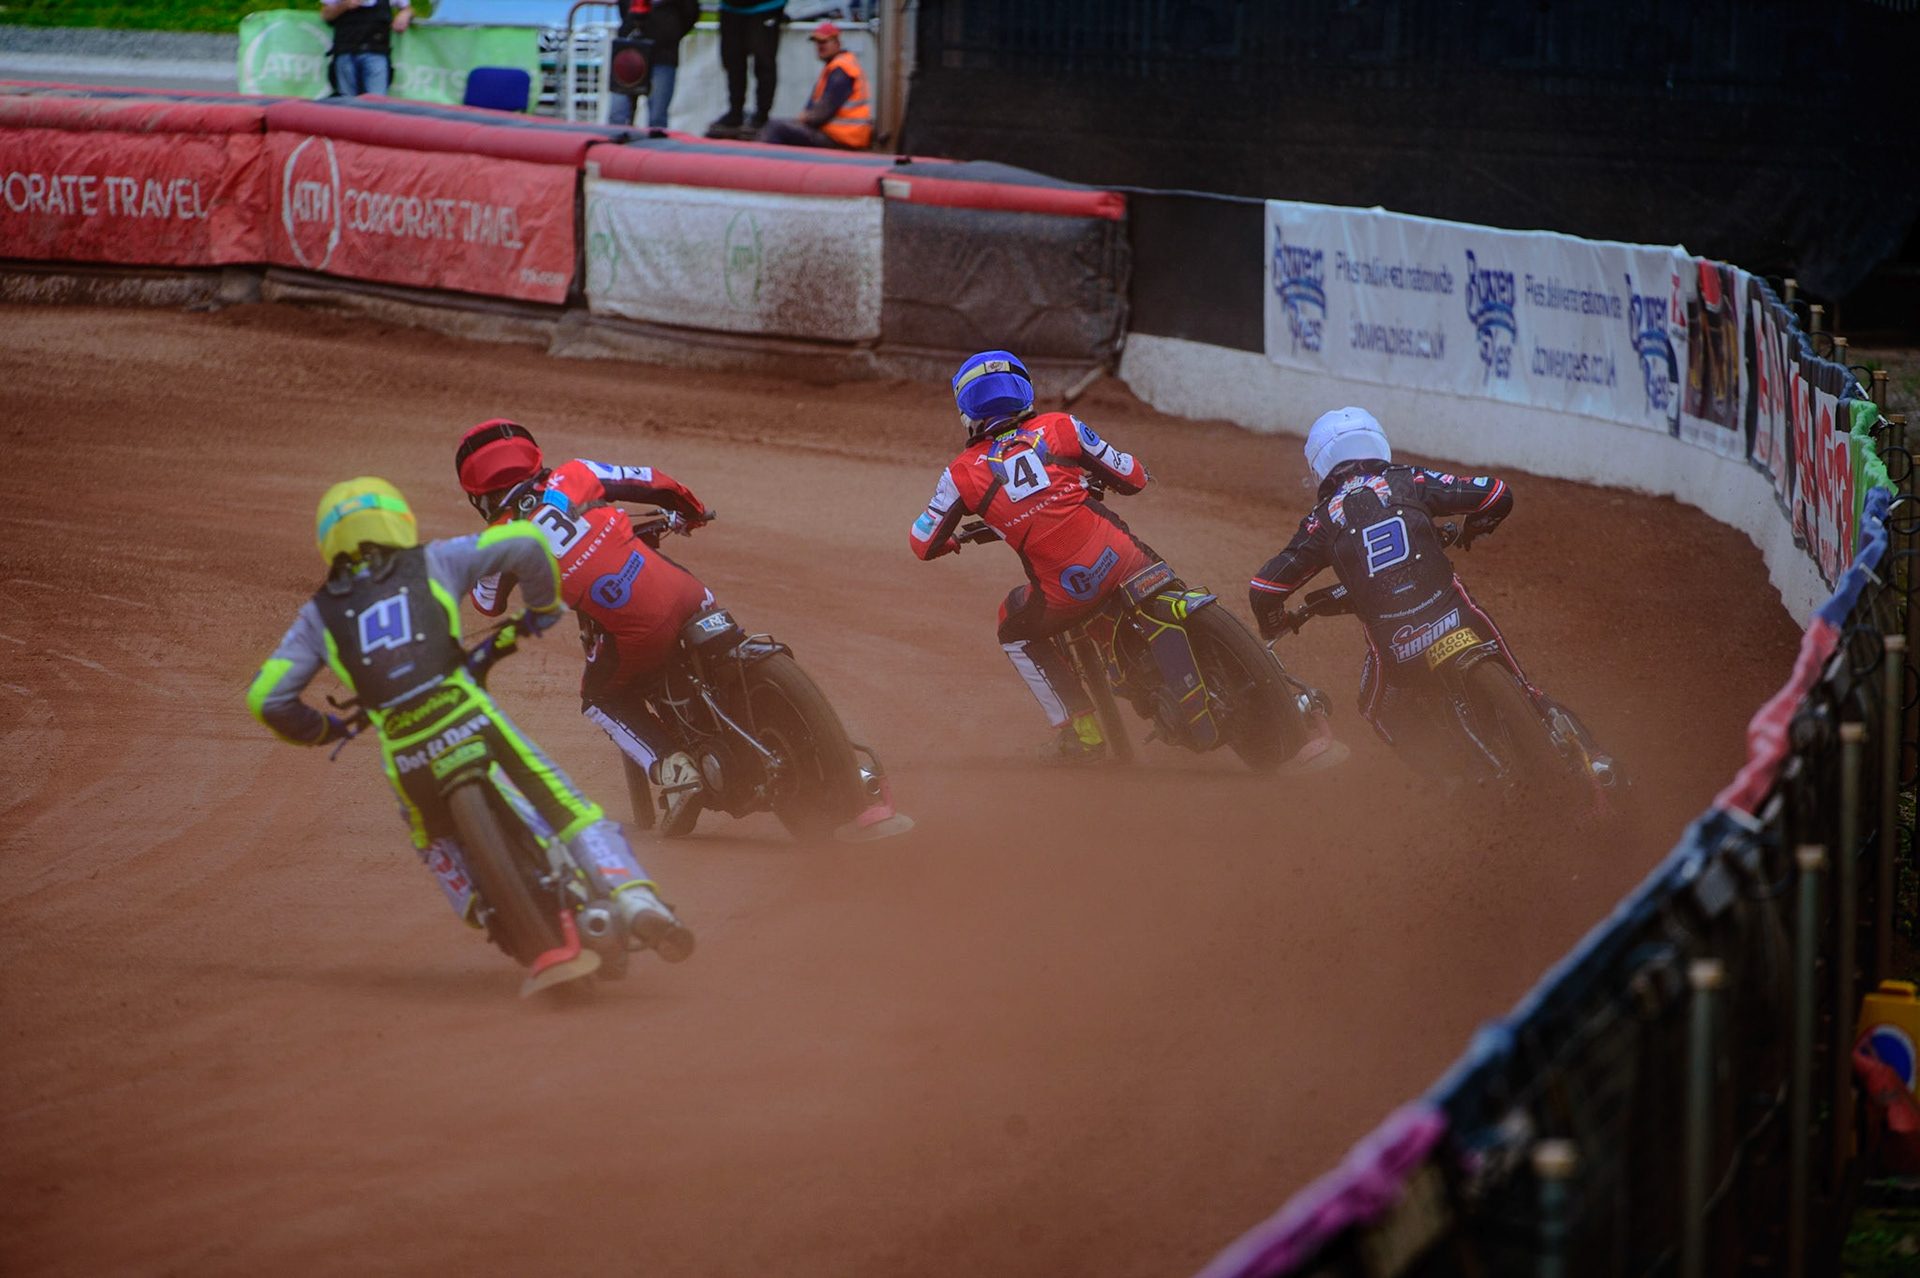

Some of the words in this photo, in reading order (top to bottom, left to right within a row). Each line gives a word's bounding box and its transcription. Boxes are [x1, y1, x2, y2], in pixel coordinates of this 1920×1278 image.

[0, 171, 98, 217] ORATE
[103, 176, 208, 220] TRAVEL
[1014, 455, 1039, 488] 4
[538, 508, 577, 548] 3
[1004, 482, 1076, 528] MANCHESTER
[560, 516, 617, 581] ANCHESTER
[1361, 515, 1411, 575] 3
[358, 592, 413, 655] 4
[1397, 613, 1460, 661] HAGON
[1428, 629, 1473, 657] HAGON
[441, 713, 492, 747] Dave
